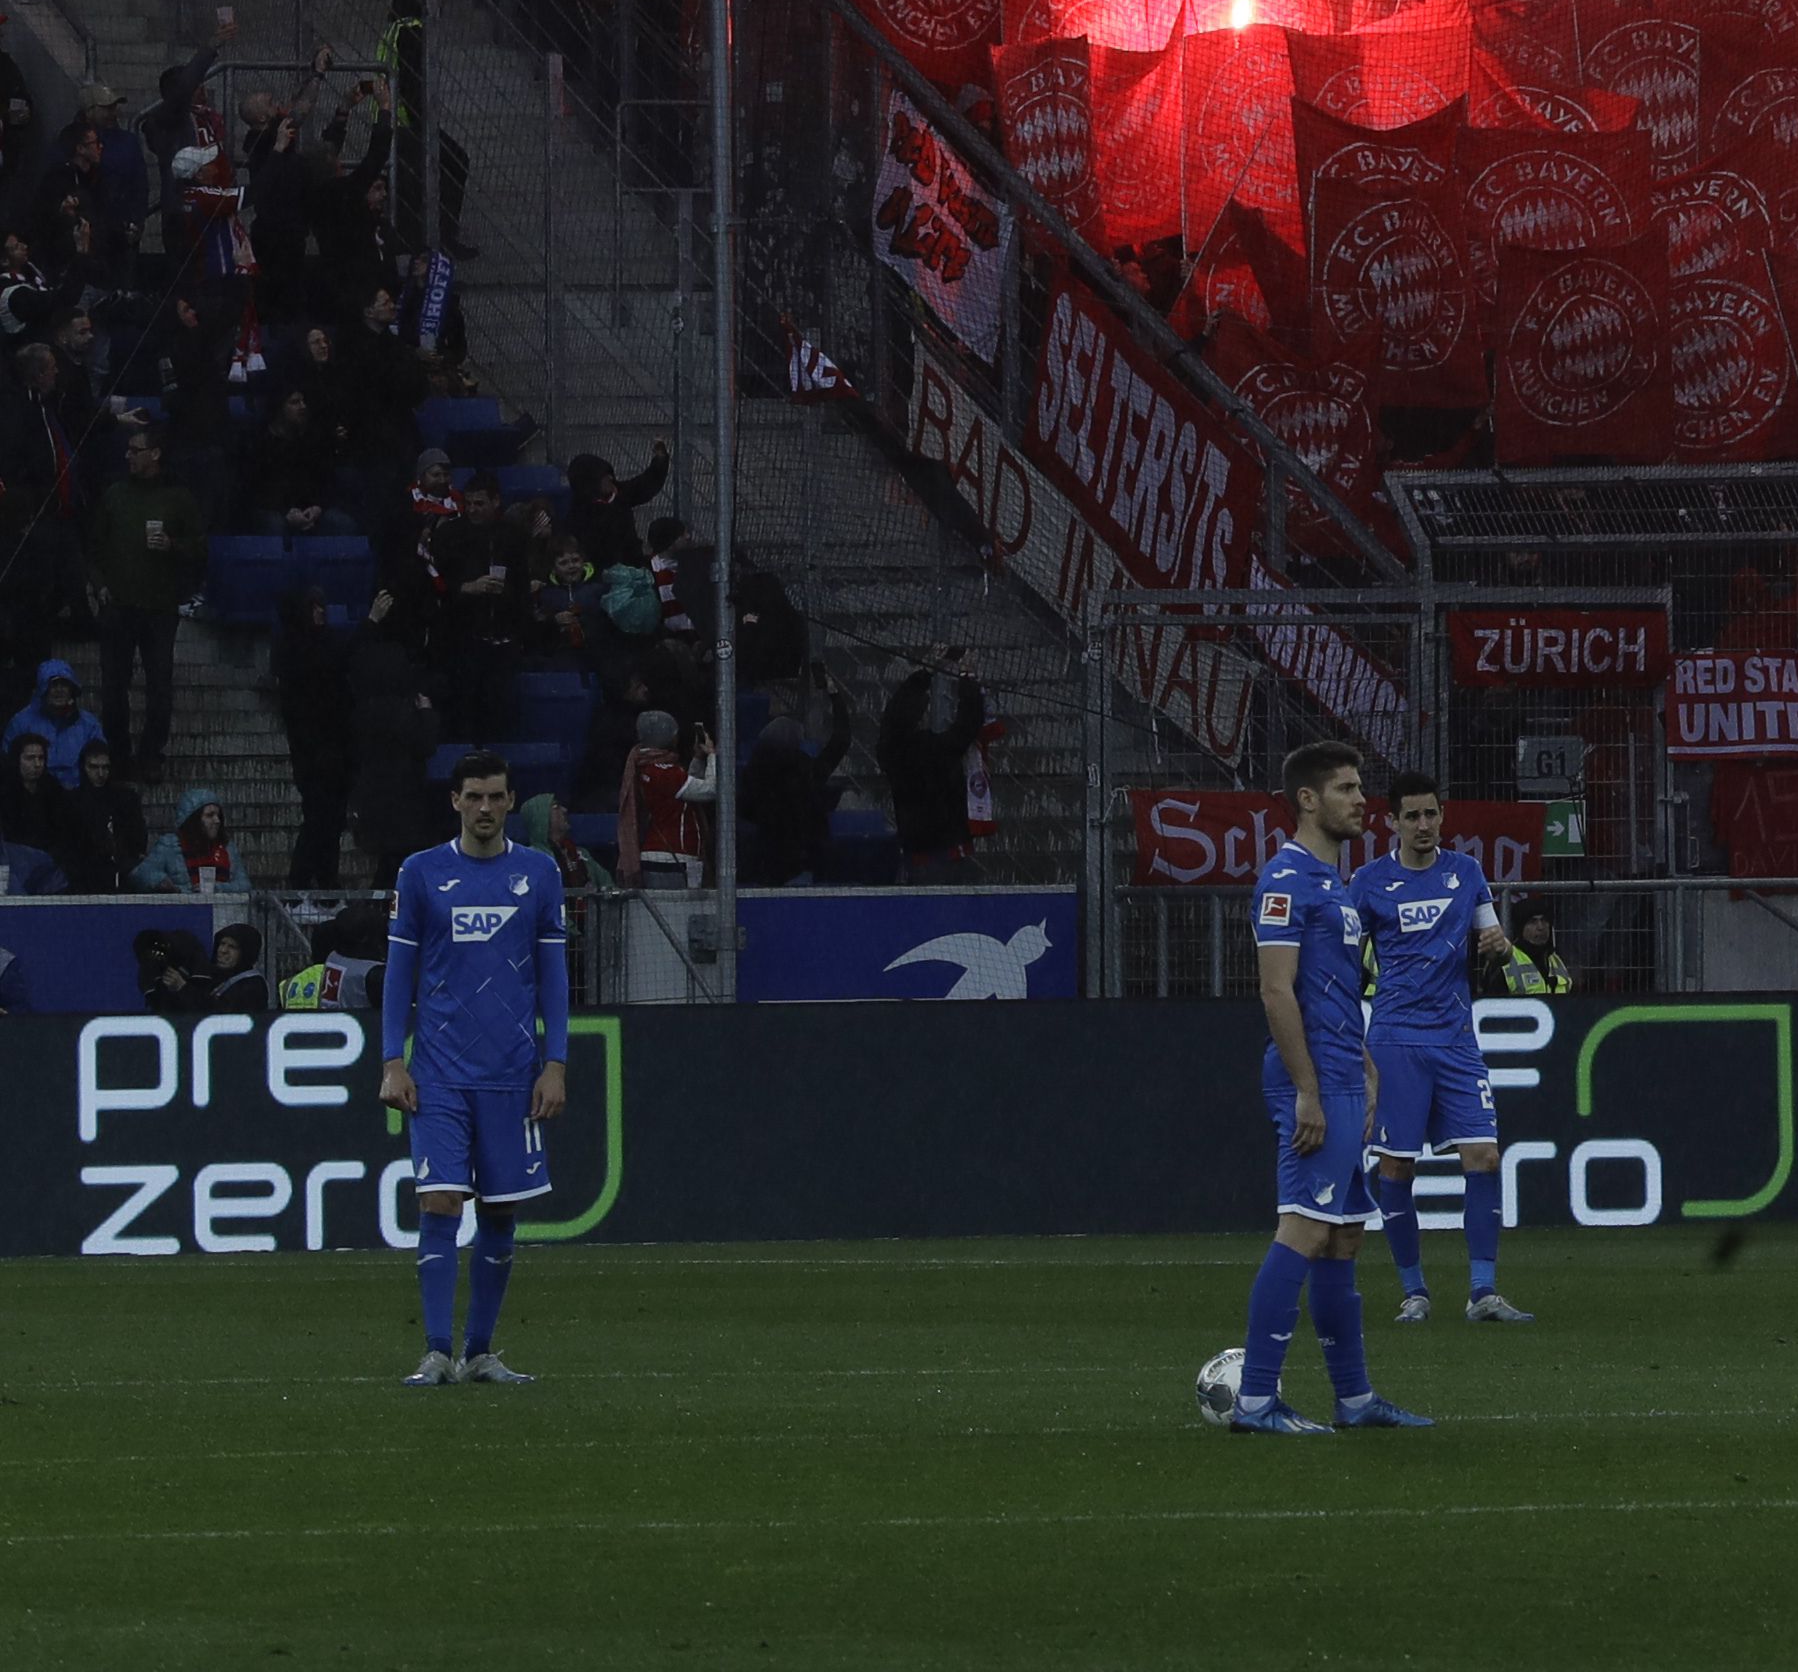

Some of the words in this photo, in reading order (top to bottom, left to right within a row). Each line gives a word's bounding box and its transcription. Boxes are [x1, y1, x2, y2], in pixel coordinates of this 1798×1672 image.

[1473, 174, 1514, 212] F.C.
[1514, 159, 1623, 229] BAYERN
[1340, 223, 1381, 265] F.C.
[1383, 205, 1454, 268] BAYERN
[1523, 293, 1557, 332] F.C.
[1557, 268, 1649, 326] BAYERN
[1512, 358, 1610, 416] MÜNCHEN
[1754, 366, 1783, 403] E.V.
[912, 364, 1034, 556] BAD
[1334, 454, 1366, 491] E.V.
[1472, 617, 1648, 674] ZÜRICH
[1674, 657, 1738, 695] RED
[1536, 748, 1568, 778] G1
[453, 912, 503, 935] SAP
[1401, 903, 1443, 927] SAP
[77, 1012, 366, 1143] pre
